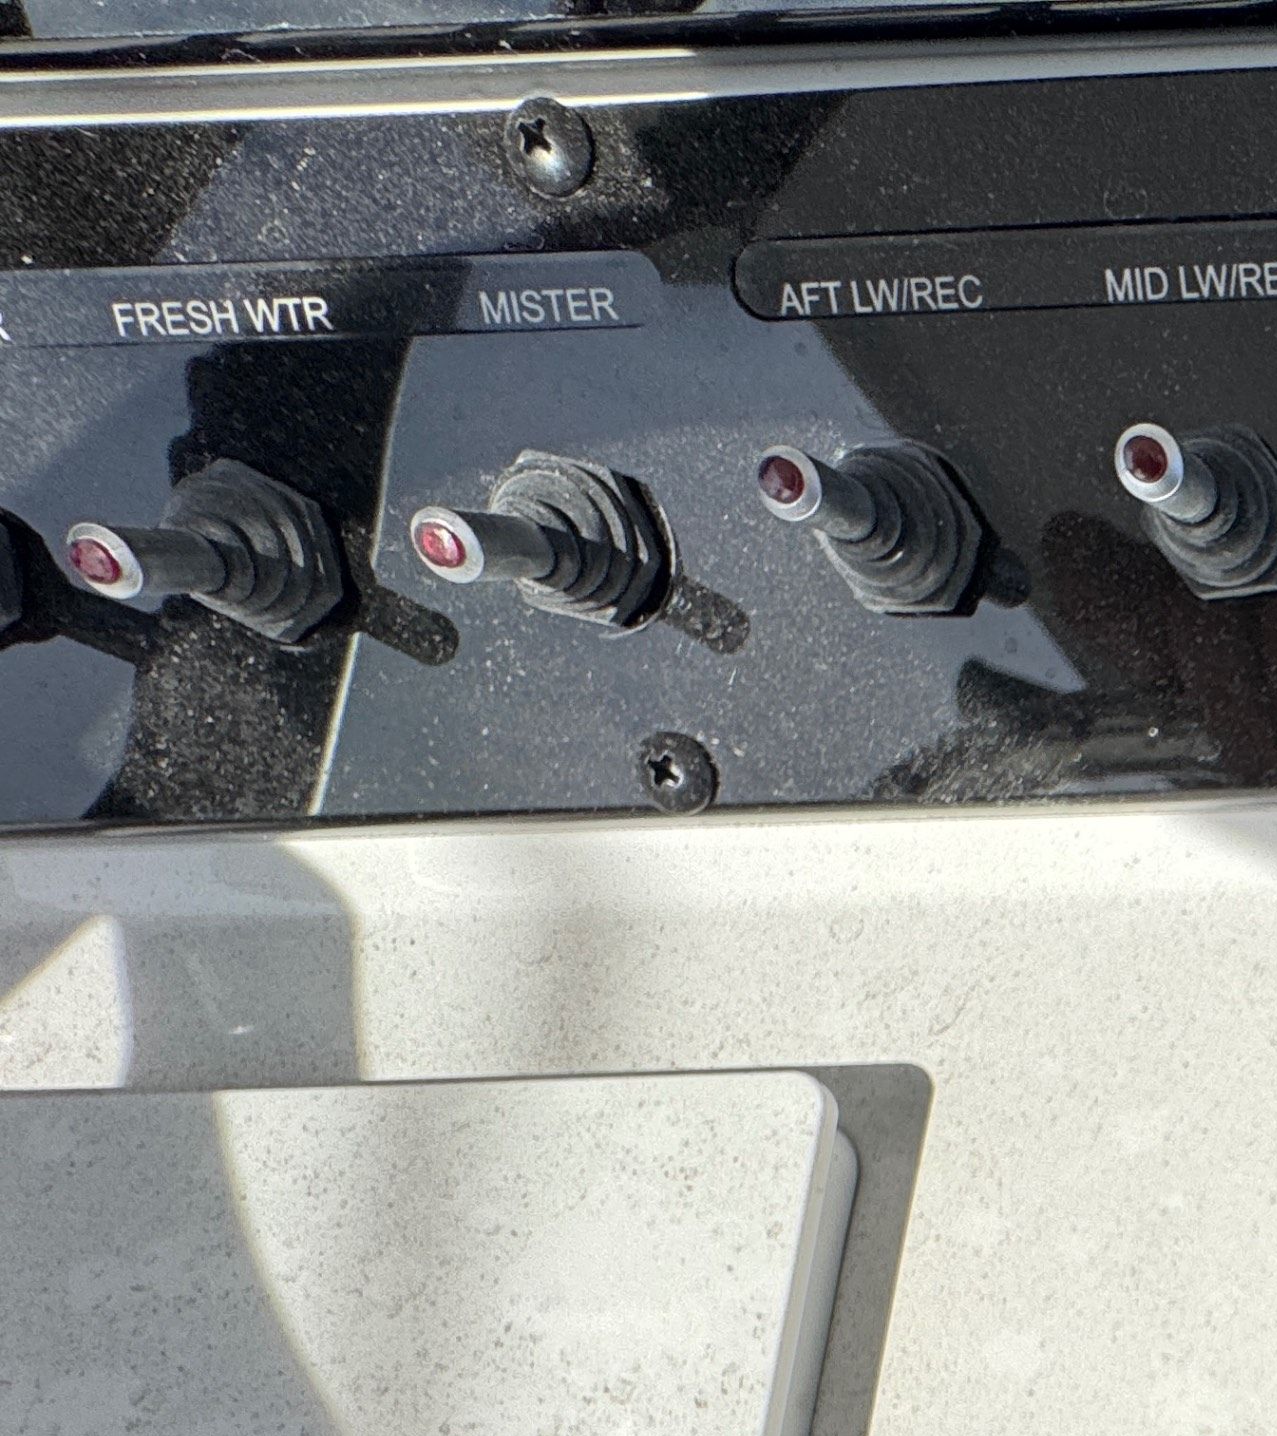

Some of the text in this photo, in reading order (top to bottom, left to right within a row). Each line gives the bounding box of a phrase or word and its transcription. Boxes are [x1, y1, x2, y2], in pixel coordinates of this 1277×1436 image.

[781, 274, 983, 315] AFT LW/REC
[1104, 266, 1169, 302] MID
[111, 296, 332, 337] FRESH WTR
[479, 287, 619, 324] MISTER
